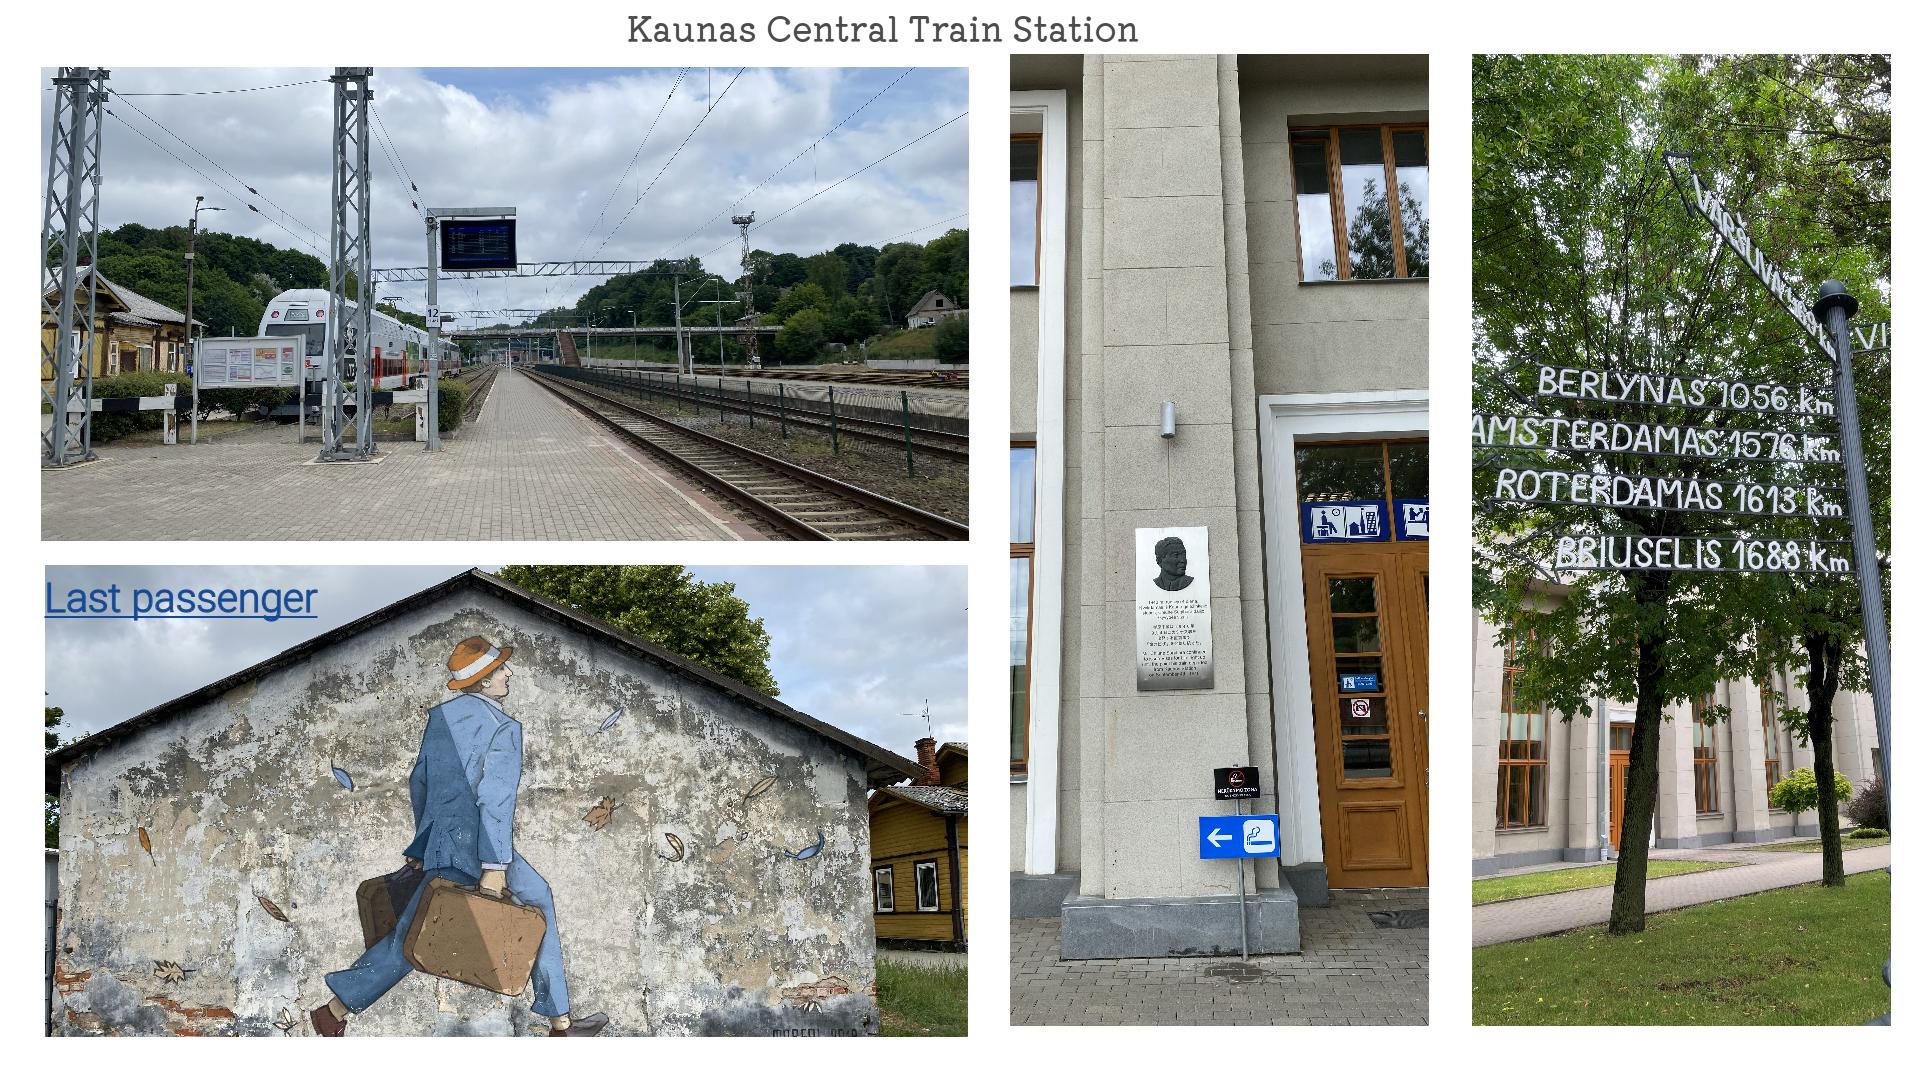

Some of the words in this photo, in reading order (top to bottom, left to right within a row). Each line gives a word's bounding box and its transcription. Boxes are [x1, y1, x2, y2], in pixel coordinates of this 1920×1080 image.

[1693, 174, 1784, 300] VARŠUVA
[427, 308, 439, 318] 12
[1537, 366, 1706, 406] BERLYNAS
[1718, 382, 1788, 412] 1056
[1800, 386, 1834, 415] km
[1472, 414, 1719, 456] AMSTERDAMAS
[1728, 430, 1796, 460] 1576
[1803, 434, 1840, 462] km
[1495, 468, 1723, 510] ROTERDAMAS
[1732, 484, 1796, 514] 1613
[1807, 487, 1843, 516] km
[1556, 536, 1722, 569] BRIUSELIS
[1732, 540, 1801, 570] 1688
[1811, 541, 1850, 572] km
